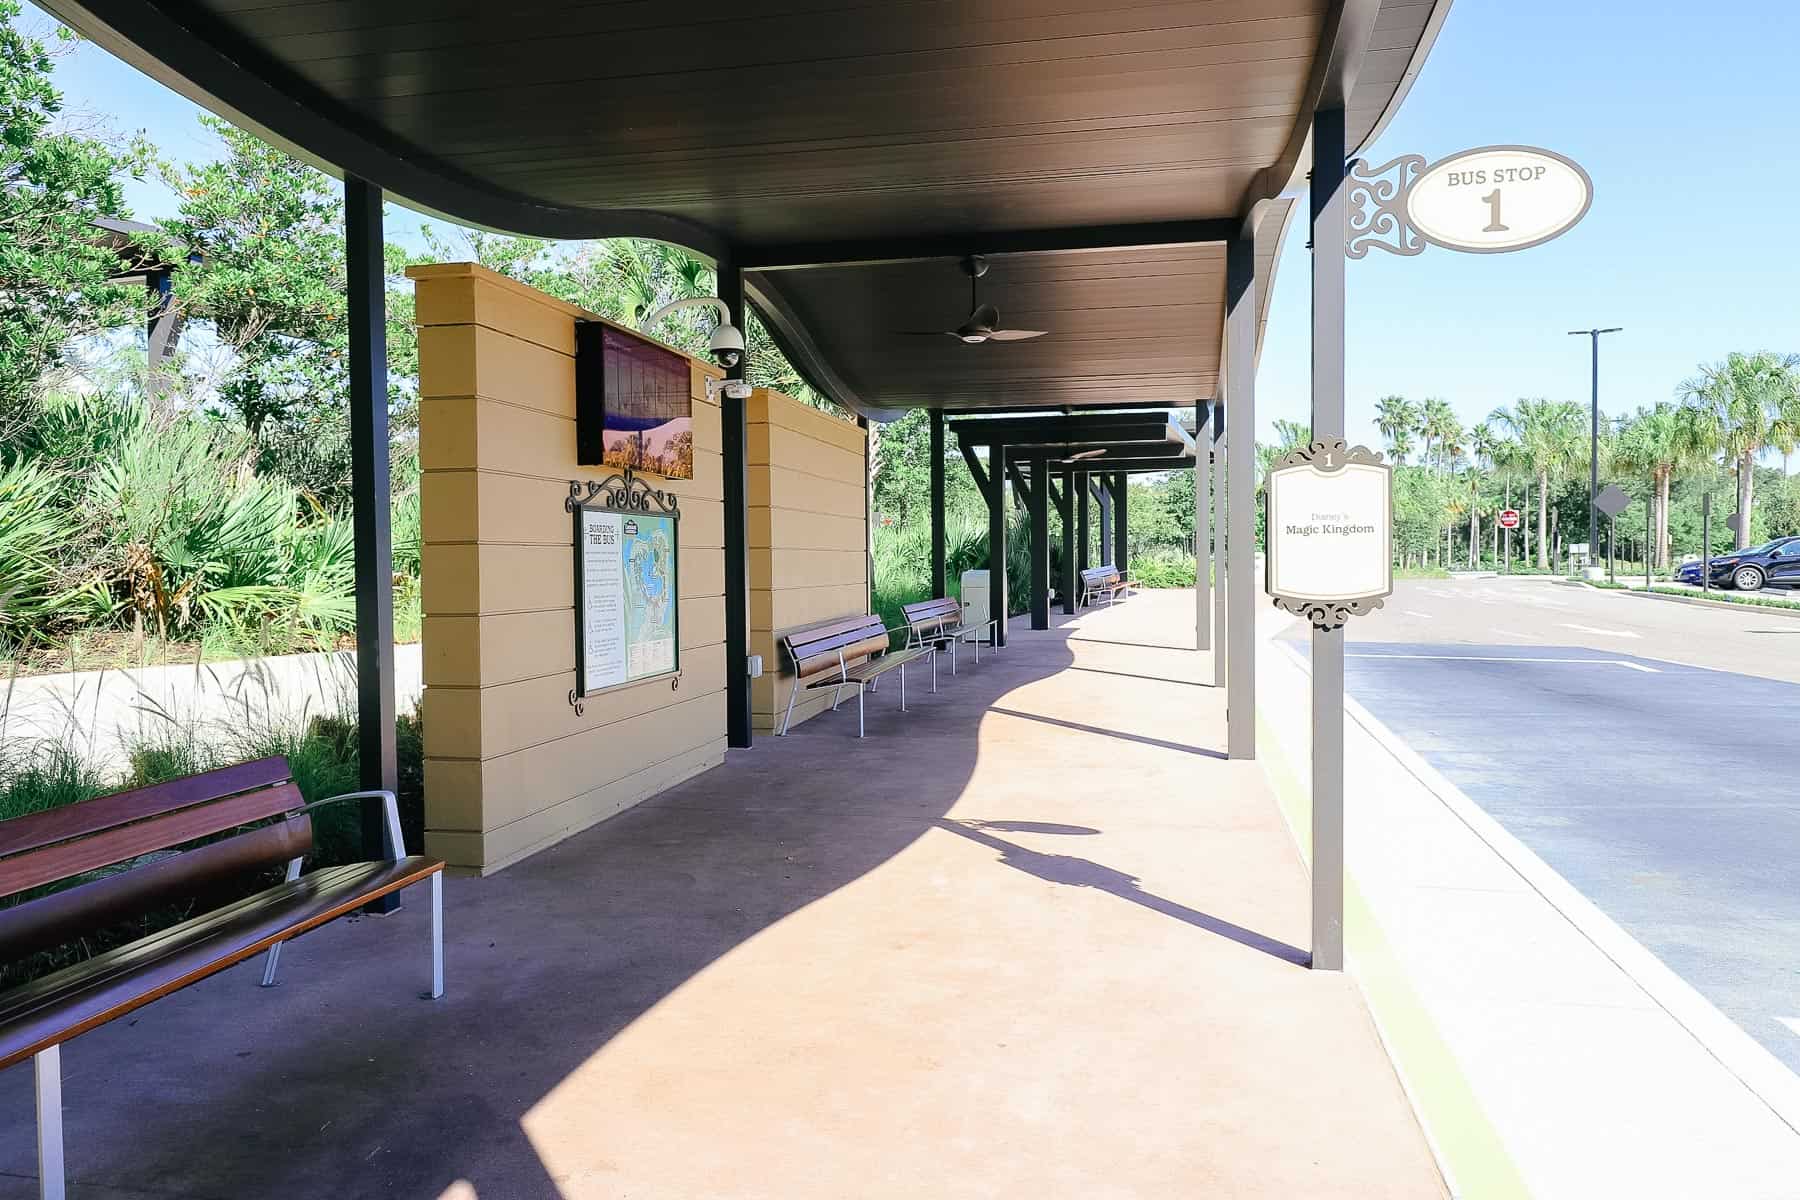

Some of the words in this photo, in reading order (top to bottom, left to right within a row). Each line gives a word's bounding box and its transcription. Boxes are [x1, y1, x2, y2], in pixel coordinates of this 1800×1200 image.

[1447, 170, 1487, 187] BUS
[1493, 166, 1546, 183] STOP
[1481, 188, 1510, 233] 1
[1325, 454, 1333, 467] 1
[1286, 525, 1319, 537] Magic
[1322, 524, 1375, 537] Kingdom
[589, 534, 602, 545] THE
[603, 535, 615, 545] BUS
